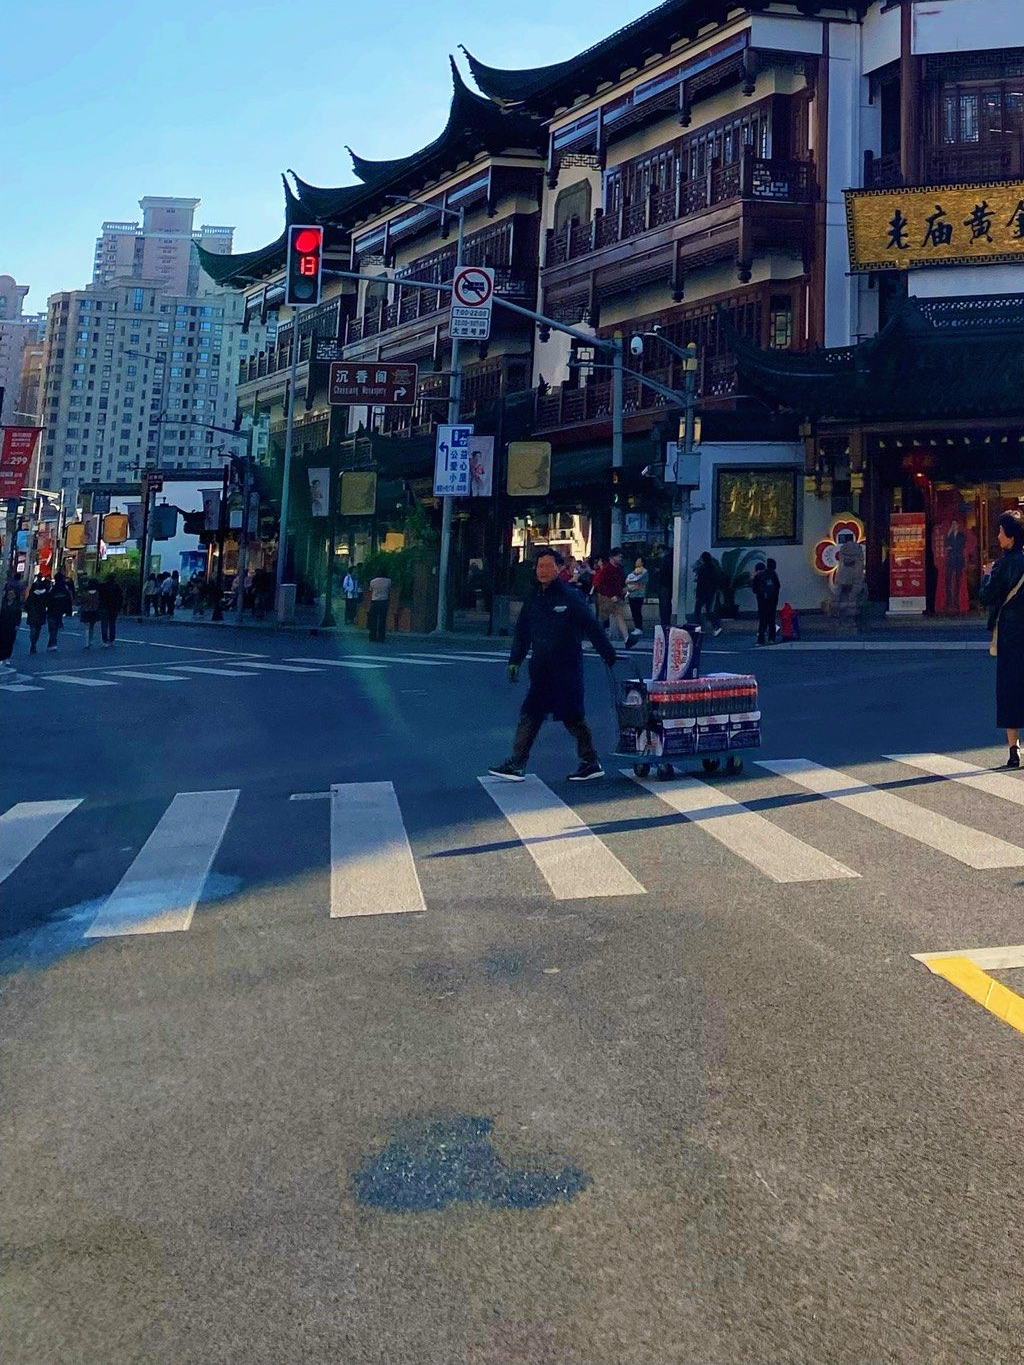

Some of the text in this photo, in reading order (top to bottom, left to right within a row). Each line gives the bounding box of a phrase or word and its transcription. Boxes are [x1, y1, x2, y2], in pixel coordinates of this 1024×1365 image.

[300, 256, 316, 276] 13
[335, 369, 388, 384] 沉香阁
